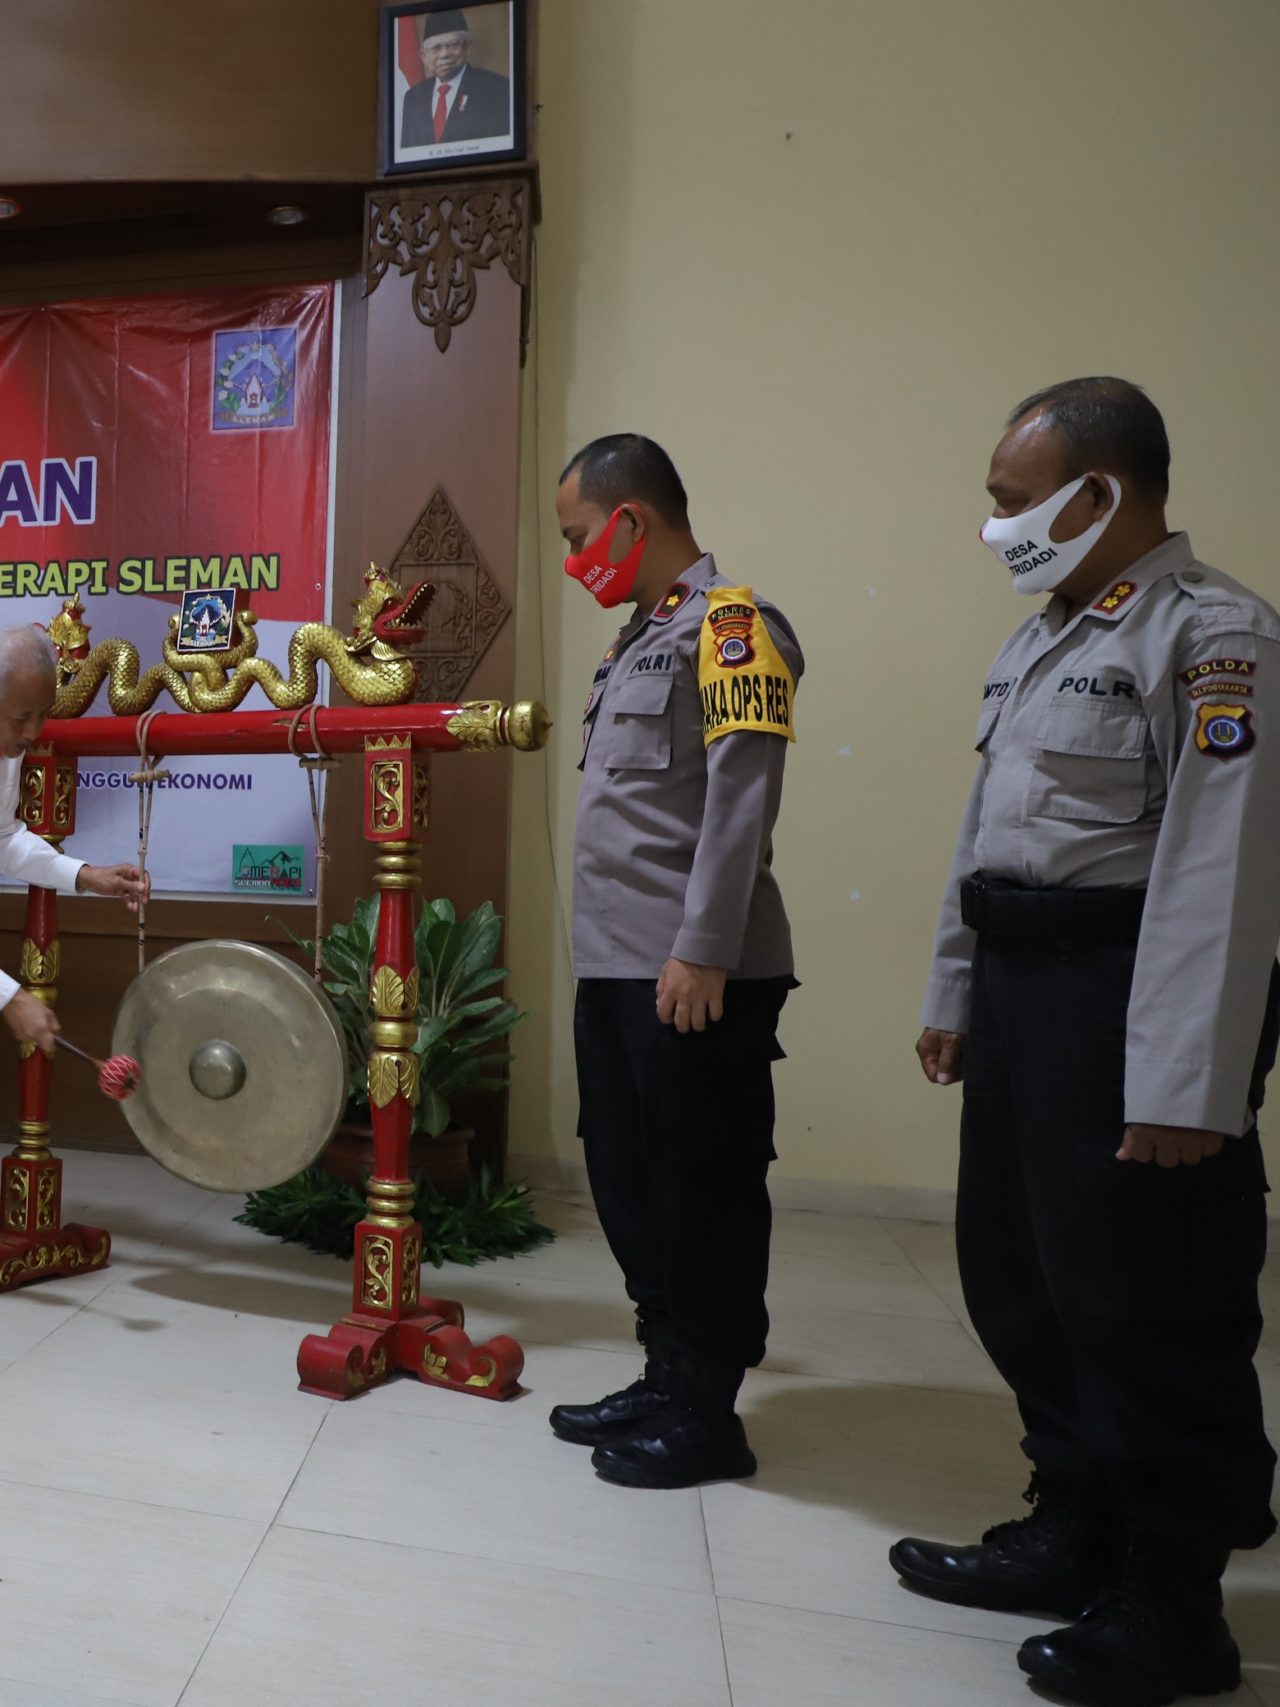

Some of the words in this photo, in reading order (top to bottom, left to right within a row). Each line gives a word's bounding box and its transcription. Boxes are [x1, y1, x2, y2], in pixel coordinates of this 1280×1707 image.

[1004, 539, 1038, 562] DESA
[1008, 547, 1058, 577] TRIDADI
[119, 553, 280, 594] SLEMAN
[583, 565, 603, 584] DESA
[711, 606, 751, 620] POLRES
[1186, 660, 1249, 680] POLDA
[1058, 676, 1136, 699] POLR
[700, 679, 730, 734] AKA
[731, 673, 763, 722] OPS
[765, 674, 789, 728] RES
[157, 773, 252, 790] EKONOMI
